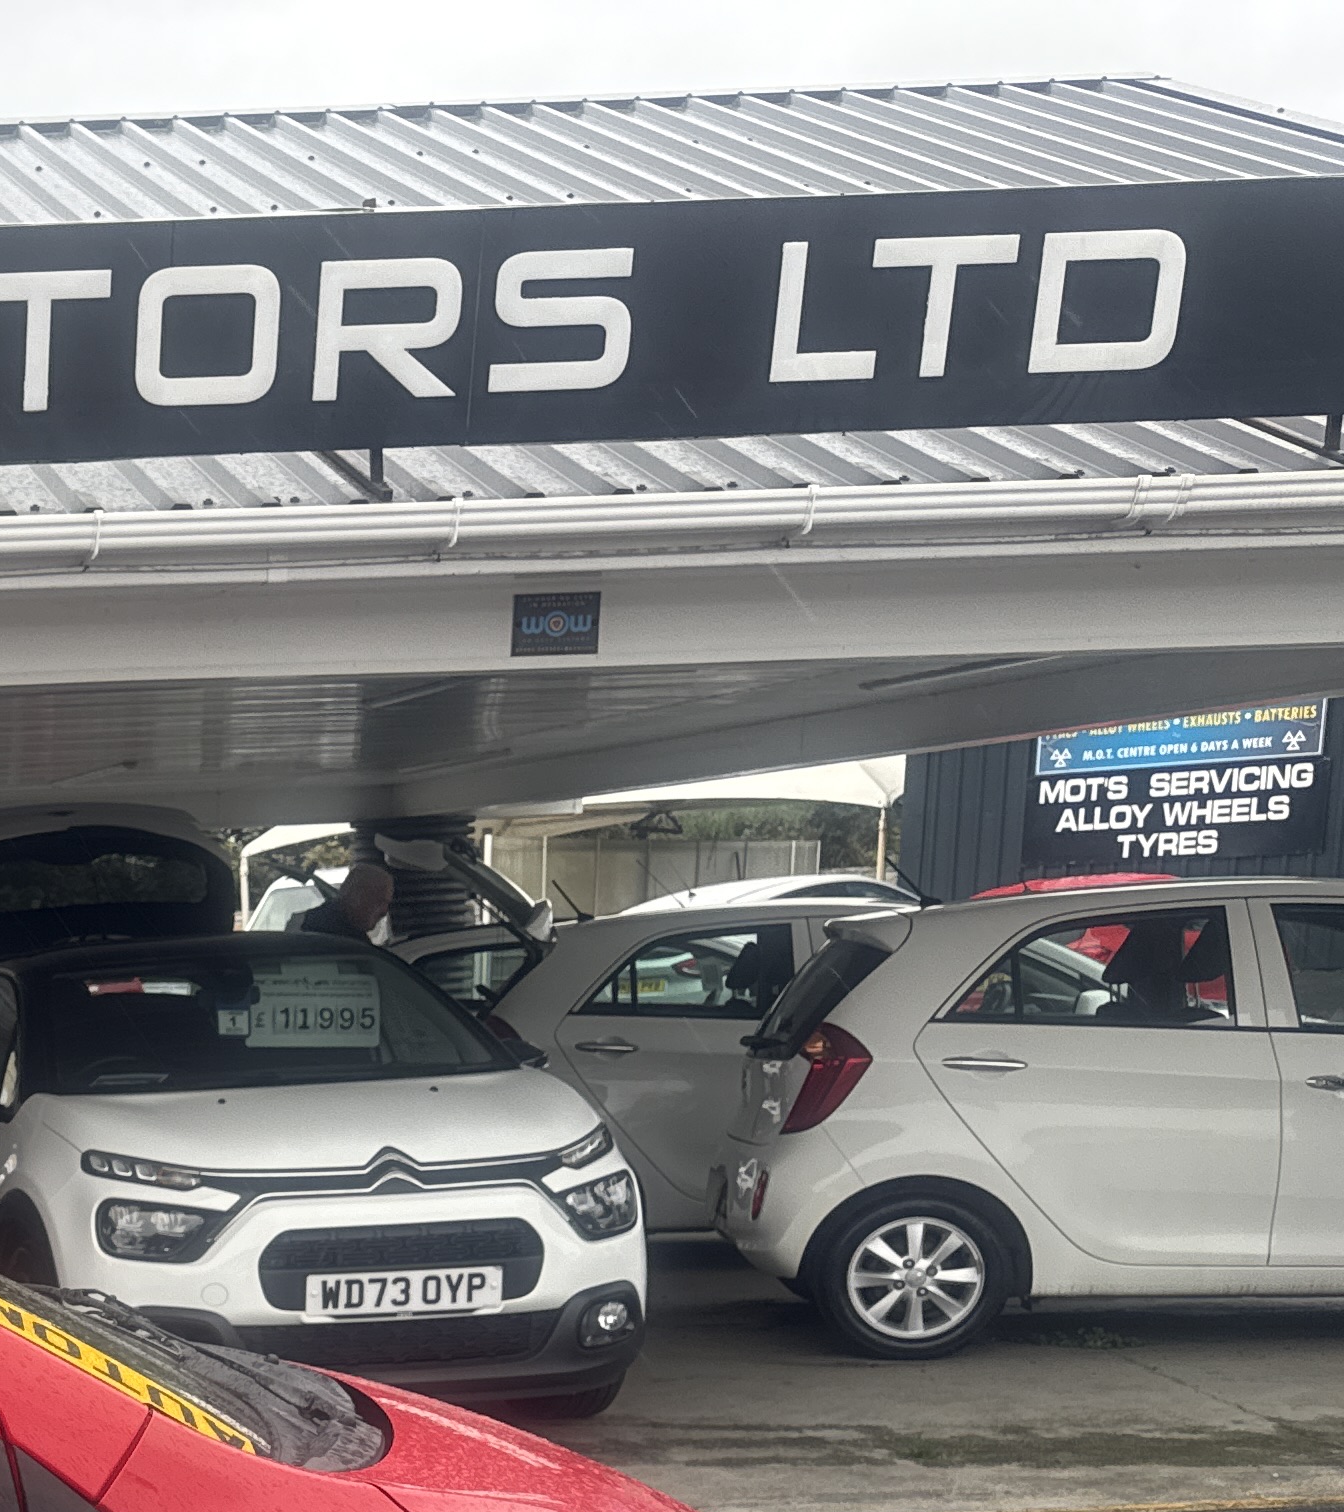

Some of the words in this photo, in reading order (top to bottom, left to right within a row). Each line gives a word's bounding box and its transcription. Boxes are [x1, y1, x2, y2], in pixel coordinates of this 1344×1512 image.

[768, 228, 1187, 383] LTD
[1182, 711, 1242, 729] EXHAUSTS
[1254, 705, 1317, 722] BATTERIES
[1117, 745, 1157, 758] CENTRE
[1159, 743, 1188, 755] OPEN
[1190, 742, 1198, 753] 6
[1200, 739, 1229, 752] DAYS
[1231, 738, 1239, 750] A
[1242, 736, 1273, 749] WEEK
[1038, 775, 1128, 804] MOT'S
[1149, 762, 1314, 797] SERVICING
[1055, 803, 1153, 832] ALLOY
[1163, 795, 1290, 826] WHEELS
[1117, 829, 1218, 858] TYRES
[321, 1277, 410, 1309] WD73
[421, 1273, 486, 1305] OYP
